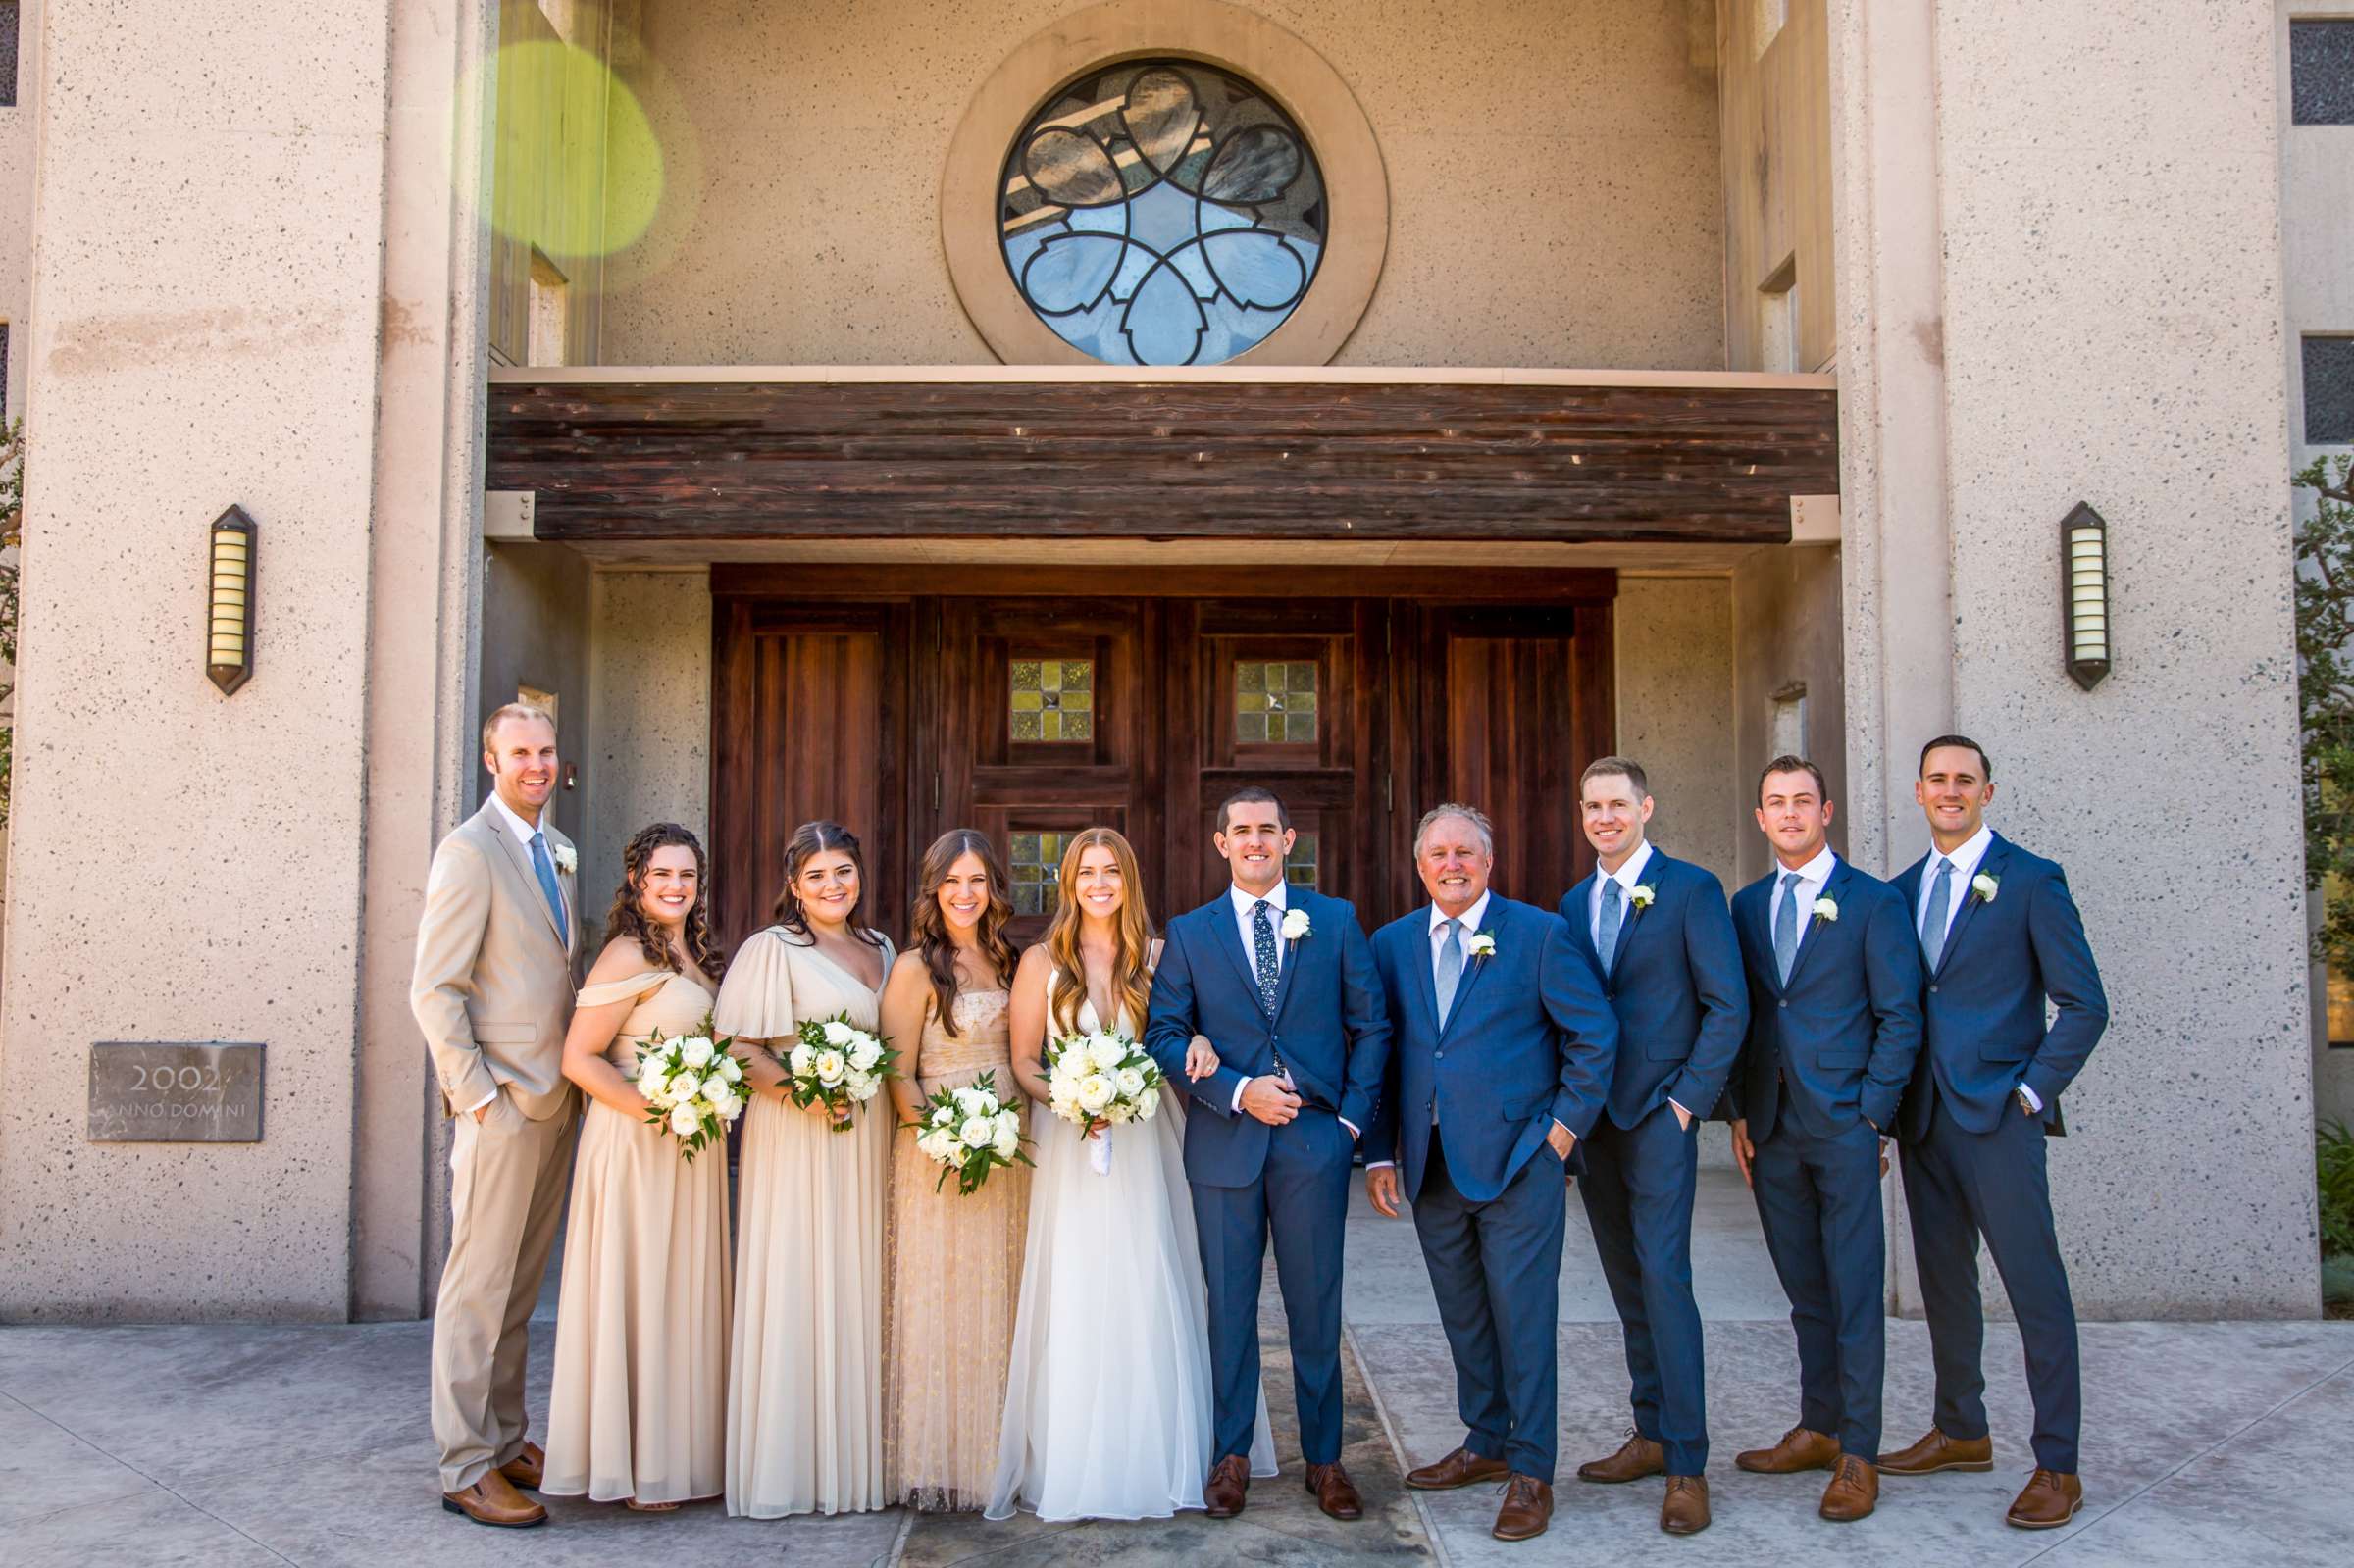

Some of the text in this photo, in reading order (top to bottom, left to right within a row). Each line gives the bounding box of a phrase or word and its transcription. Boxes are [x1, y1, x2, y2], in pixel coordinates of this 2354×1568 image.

[130, 1065, 221, 1091] 2002
[108, 1103, 246, 1118] ANNO DOMINI
